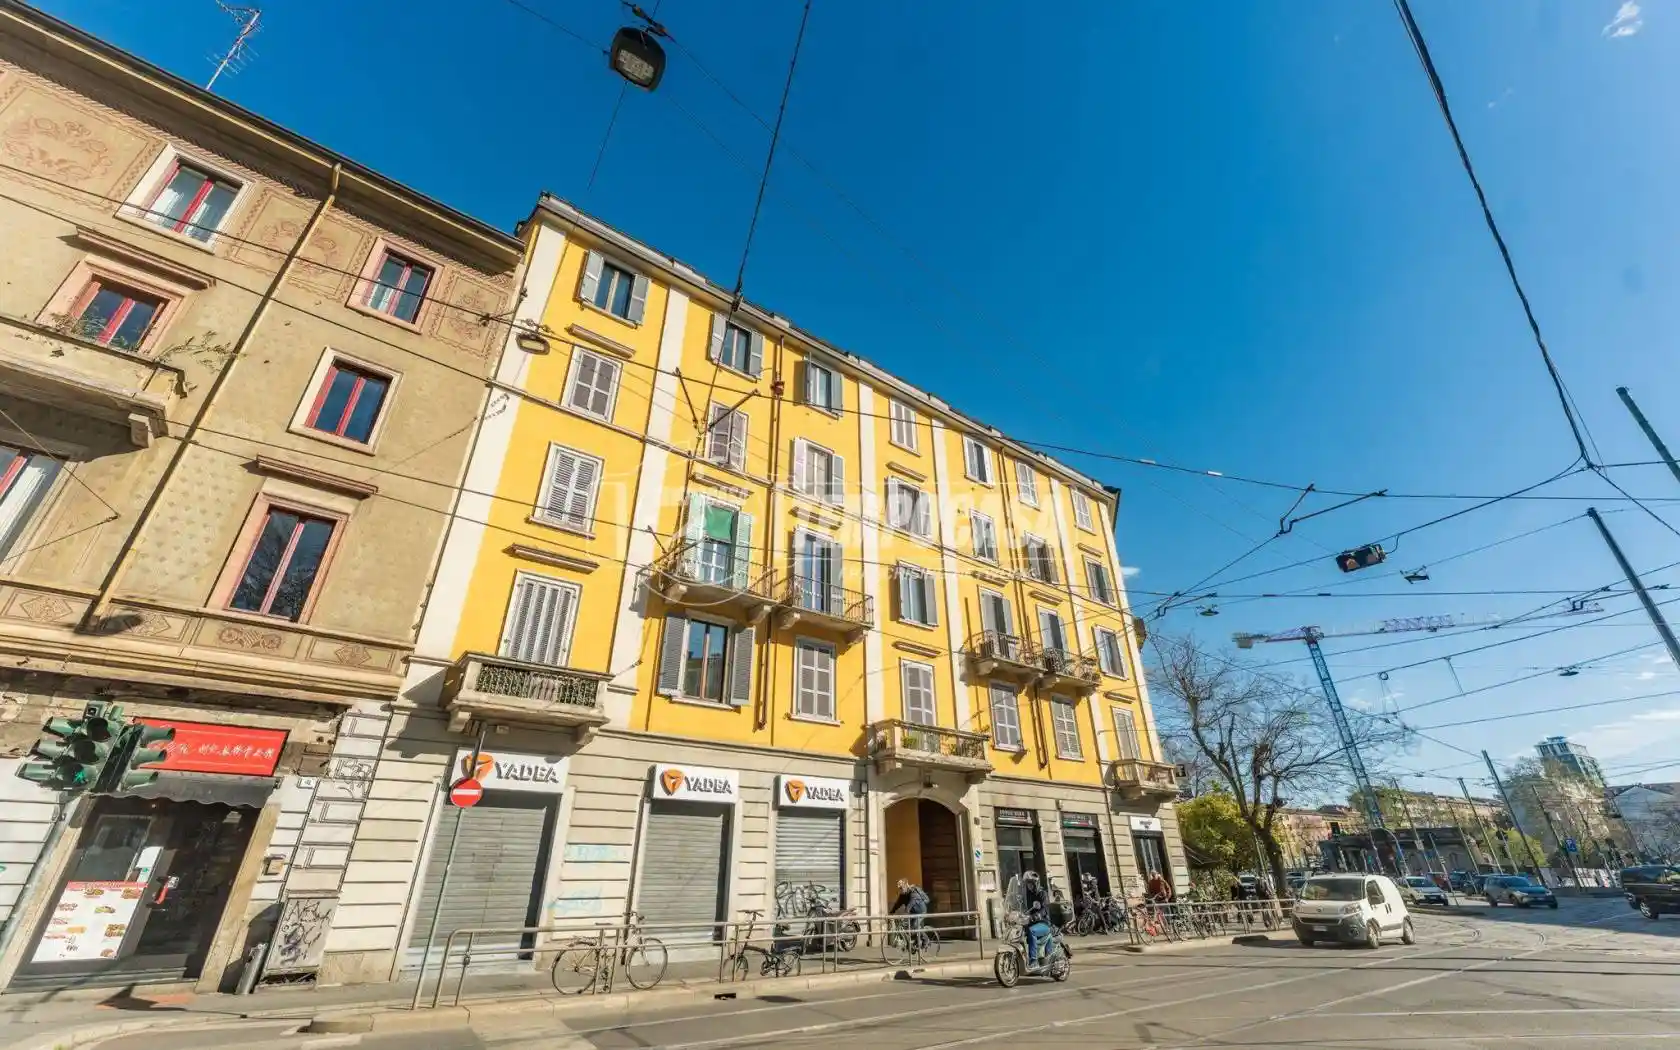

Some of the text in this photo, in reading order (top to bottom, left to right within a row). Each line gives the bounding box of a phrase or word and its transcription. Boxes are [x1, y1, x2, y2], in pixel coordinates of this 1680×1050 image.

[495, 761, 559, 784] YADEA
[684, 775, 733, 794] YADEA
[804, 785, 845, 802] YADEA
